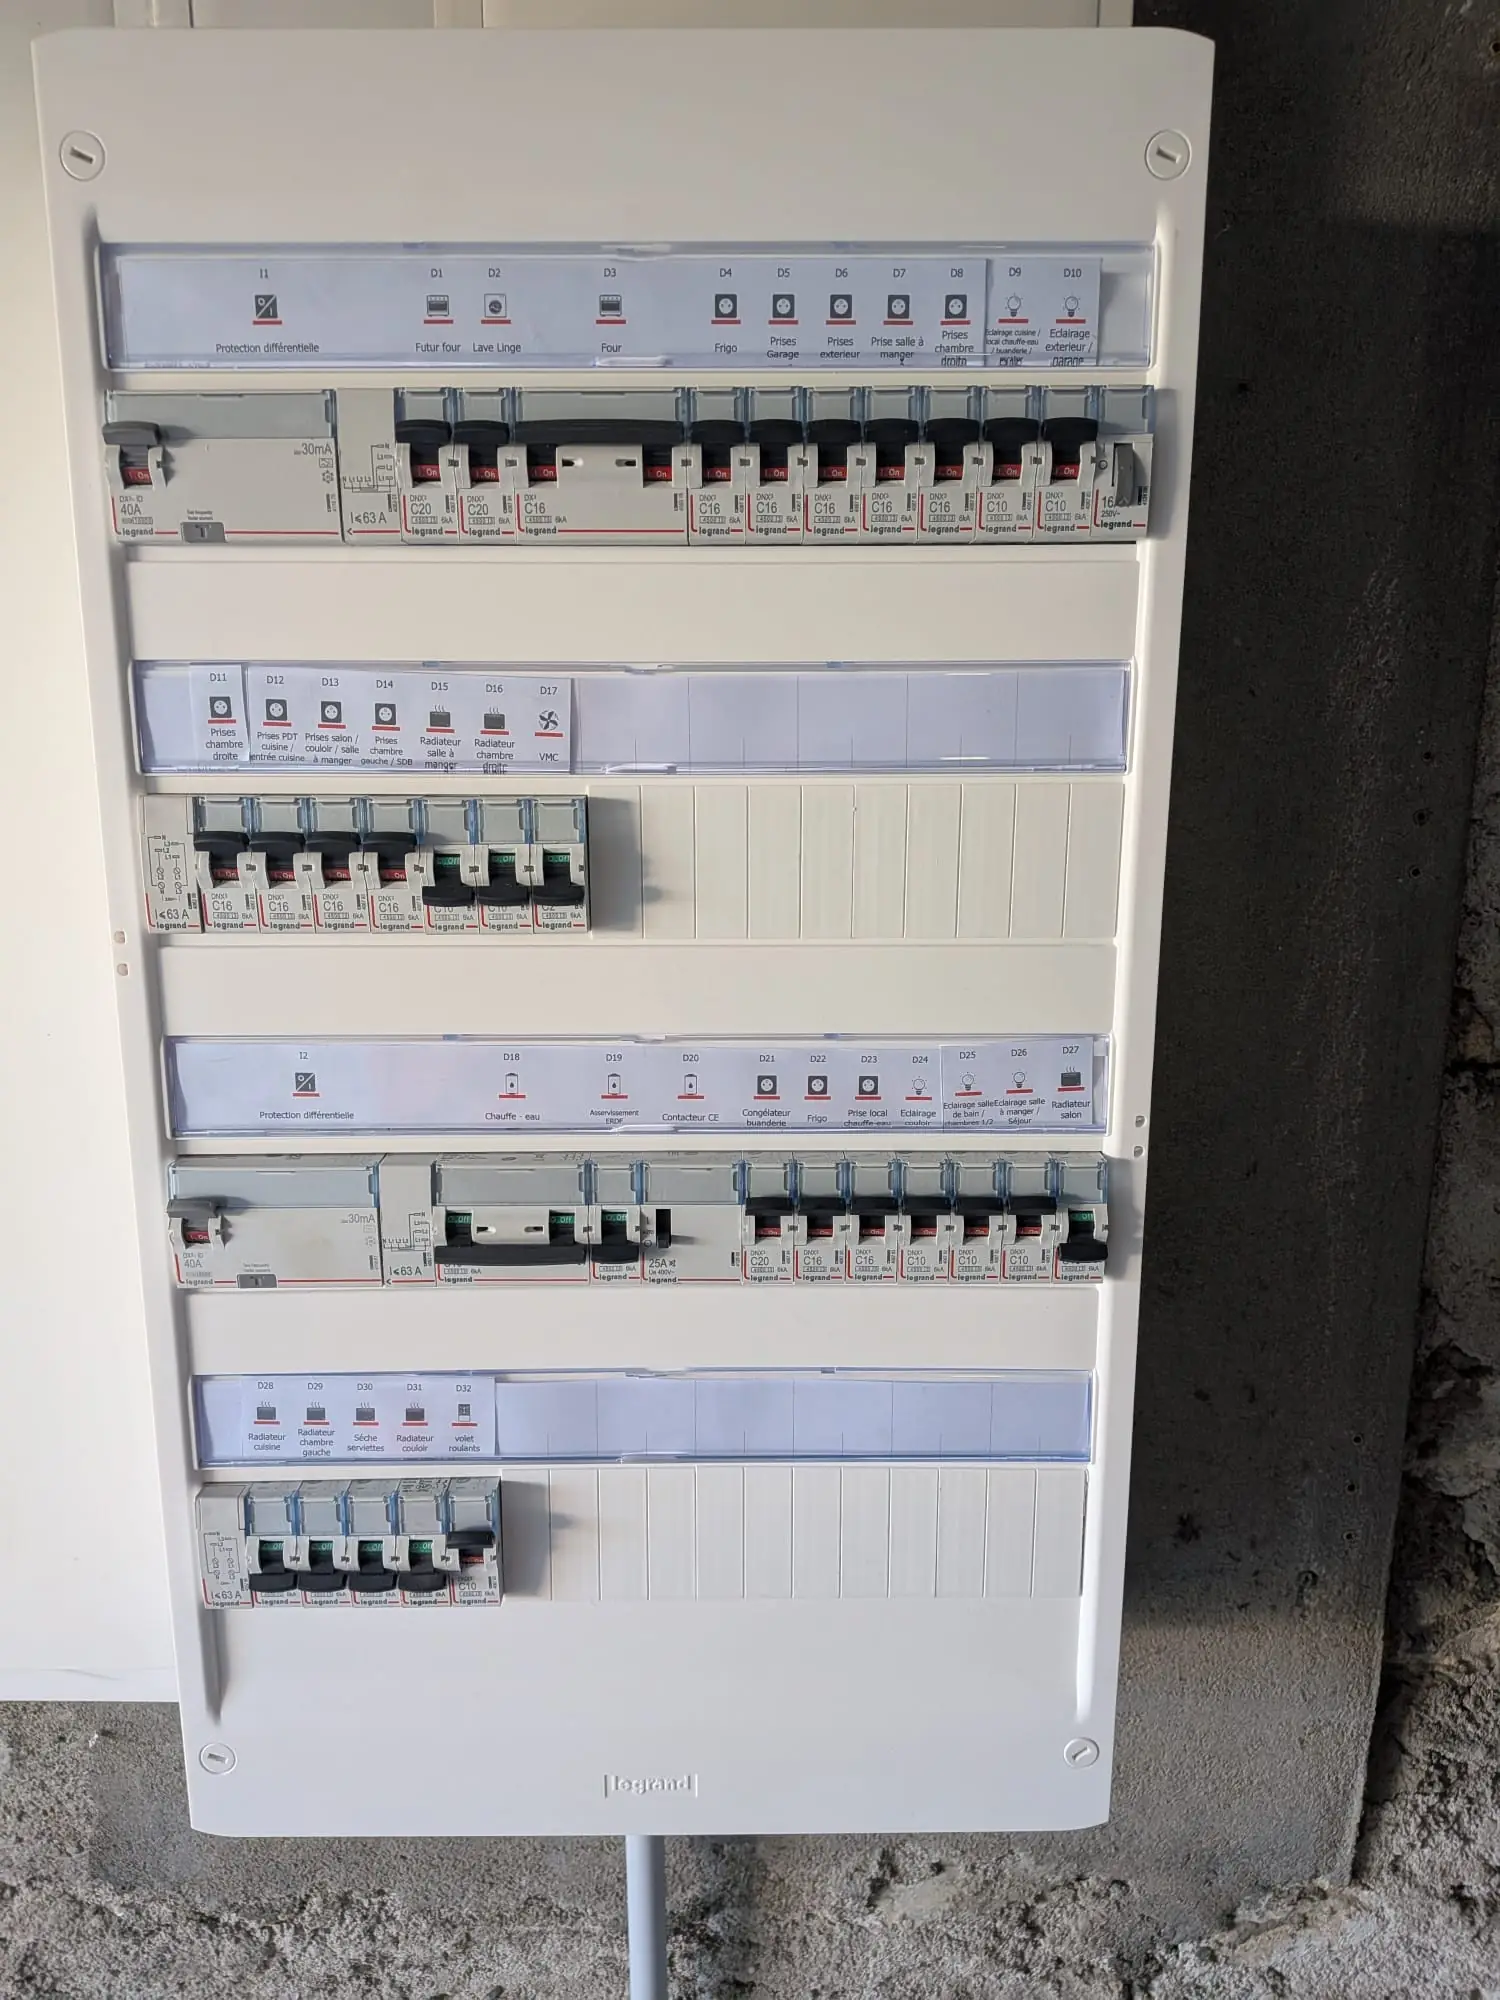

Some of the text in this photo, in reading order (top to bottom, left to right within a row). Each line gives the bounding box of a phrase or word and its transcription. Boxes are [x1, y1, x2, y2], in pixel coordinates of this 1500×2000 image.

[431, 268, 443, 278] D1
[488, 268, 501, 278] D2
[603, 268, 617, 278] D3
[719, 268, 732, 278] D4
[777, 268, 790, 278] D5
[835, 268, 848, 278] D6
[893, 268, 906, 278] D7
[951, 268, 963, 278] D8
[1009, 267, 1022, 277] D9
[1064, 268, 1082, 278] D10
[942, 330, 968, 339] Prises
[1049, 329, 1090, 340] Eclairage
[770, 336, 797, 346] Prises
[827, 336, 854, 346] Prises
[871, 337, 893, 346] Prise
[895, 336, 915, 346] salle
[216, 342, 320, 353] Protection différentielle
[415, 342, 461, 352] Futur four
[472, 342, 521, 354] Lave Linge
[601, 342, 622, 352] Four
[714, 343, 738, 354] Frigo
[934, 343, 974, 353] chambre
[1045, 342, 1085, 352] exterieur
[766, 350, 800, 360] Garage
[820, 350, 860, 359] exterieur
[120, 503, 142, 515] 40A
[410, 503, 432, 515] C20
[524, 503, 546, 514] C16
[699, 503, 721, 515] C16
[871, 501, 893, 513] C16
[986, 501, 1008, 512] C10
[1043, 523, 1076, 532] legrand
[1100, 519, 1132, 529] legrand
[122, 527, 154, 536] legrand
[411, 527, 443, 536] legrand
[525, 526, 557, 535] legrand
[699, 526, 731, 536] legrand
[870, 525, 902, 534] legrand
[209, 673, 227, 682] D11
[266, 676, 284, 685] D12
[322, 678, 339, 687] D13
[376, 680, 393, 689] D14
[431, 682, 449, 691] D15
[486, 684, 504, 693] D16
[540, 686, 558, 695] D17
[210, 729, 236, 737] Prises
[257, 732, 298, 741] Prises PDT
[305, 733, 353, 743] Prises salon
[375, 736, 398, 745] Prises
[420, 737, 461, 746] Radiateur
[205, 739, 243, 749] chambre
[261, 743, 288, 751] cuisine
[474, 739, 515, 748] Radiateur
[305, 744, 360, 754] couloir salle
[369, 747, 404, 756] chambre
[427, 749, 446, 757] salle
[213, 751, 238, 761] droite
[278, 754, 305, 762] cuisine
[476, 751, 514, 760] chambre
[539, 753, 559, 762] VMC
[313, 755, 353, 766] à manger
[360, 757, 413, 767] gauche SDB
[212, 901, 233, 912] C16
[323, 901, 344, 912] C16
[156, 921, 187, 930] legrand
[324, 921, 355, 931] legrand
[1011, 1048, 1027, 1057] D26
[1062, 1046, 1079, 1054] D27
[503, 1053, 520, 1061] D18
[606, 1054, 622, 1062] D19
[683, 1054, 699, 1062] D20
[759, 1054, 775, 1063] D21
[810, 1055, 827, 1063] D22
[861, 1055, 878, 1063] D23
[959, 1051, 976, 1059] D25
[912, 1056, 928, 1064] D24
[943, 1102, 976, 1111] Eclairage
[1051, 1100, 1091, 1109] Radiateur
[259, 1110, 354, 1120] Protection différentielle
[485, 1111, 517, 1121] Chauffe
[662, 1113, 719, 1122] Contacteur CE
[742, 1108, 791, 1118] Congélateur
[848, 1109, 888, 1117] Prise local
[901, 1109, 937, 1119] Eclairage
[963, 1110, 979, 1118] bain
[1060, 1111, 1082, 1119] salon
[746, 1119, 787, 1127] buanderie
[807, 1114, 828, 1124] Frigo
[648, 1259, 667, 1268] 25A
[750, 1256, 769, 1266] C20
[648, 1276, 677, 1284] legrand
[750, 1274, 779, 1282] legrand
[257, 1381, 274, 1390] D28
[307, 1382, 323, 1390] D29
[357, 1383, 373, 1391] D30
[407, 1383, 422, 1391] D31
[456, 1384, 472, 1392] D32
[248, 1432, 286, 1441] Radiateur
[297, 1428, 335, 1437] Radiateur
[299, 1438, 334, 1447] chambre
[396, 1434, 434, 1442] Radiateur
[253, 1443, 281, 1451] cuisine
[347, 1443, 384, 1452] serviettes
[402, 1444, 428, 1452] couloir
[448, 1444, 480, 1452] roulants
[302, 1449, 331, 1458] gauche
[458, 1582, 477, 1590] C10
[611, 1775, 691, 1795] legrand
